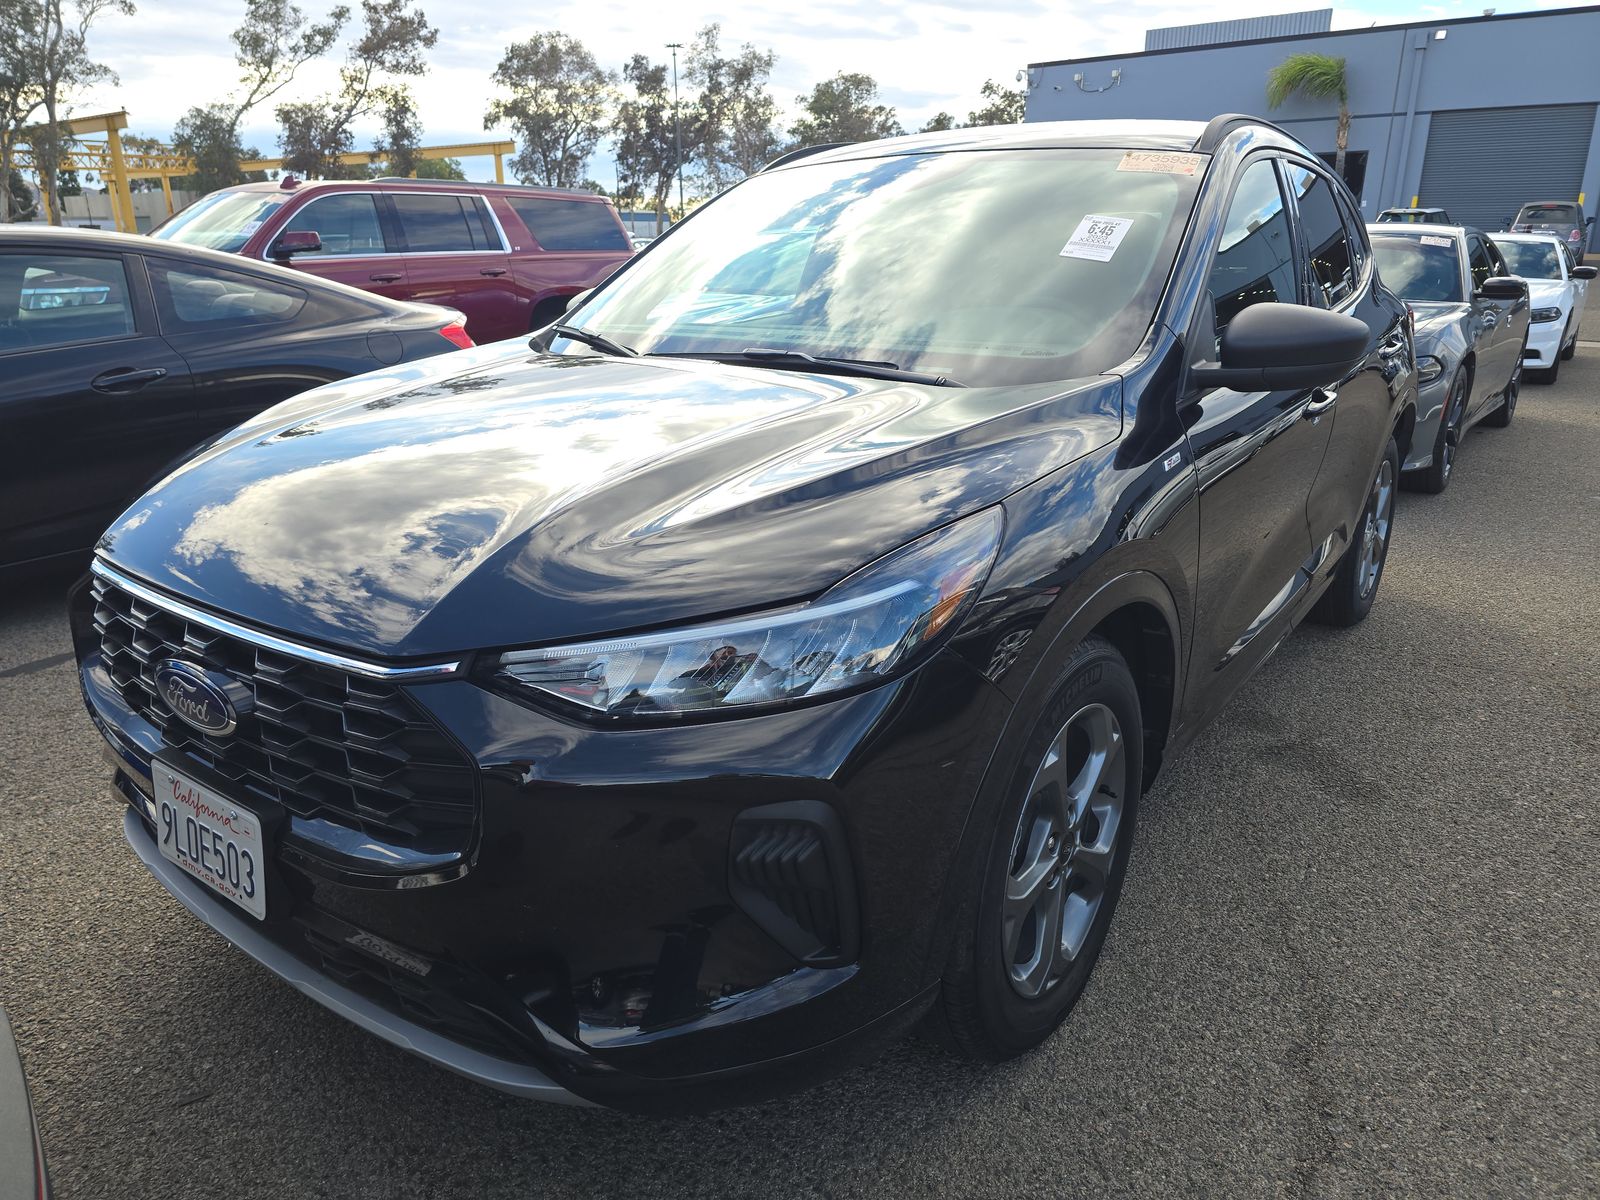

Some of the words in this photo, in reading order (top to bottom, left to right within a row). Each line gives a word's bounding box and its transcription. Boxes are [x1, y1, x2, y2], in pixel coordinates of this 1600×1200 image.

[1131, 154, 1199, 166] 4735935
[1087, 223, 1116, 236] 6:45
[166, 675, 210, 724] Ford
[173, 780, 240, 835] California
[182, 858, 238, 898] dmv.ca.gov
